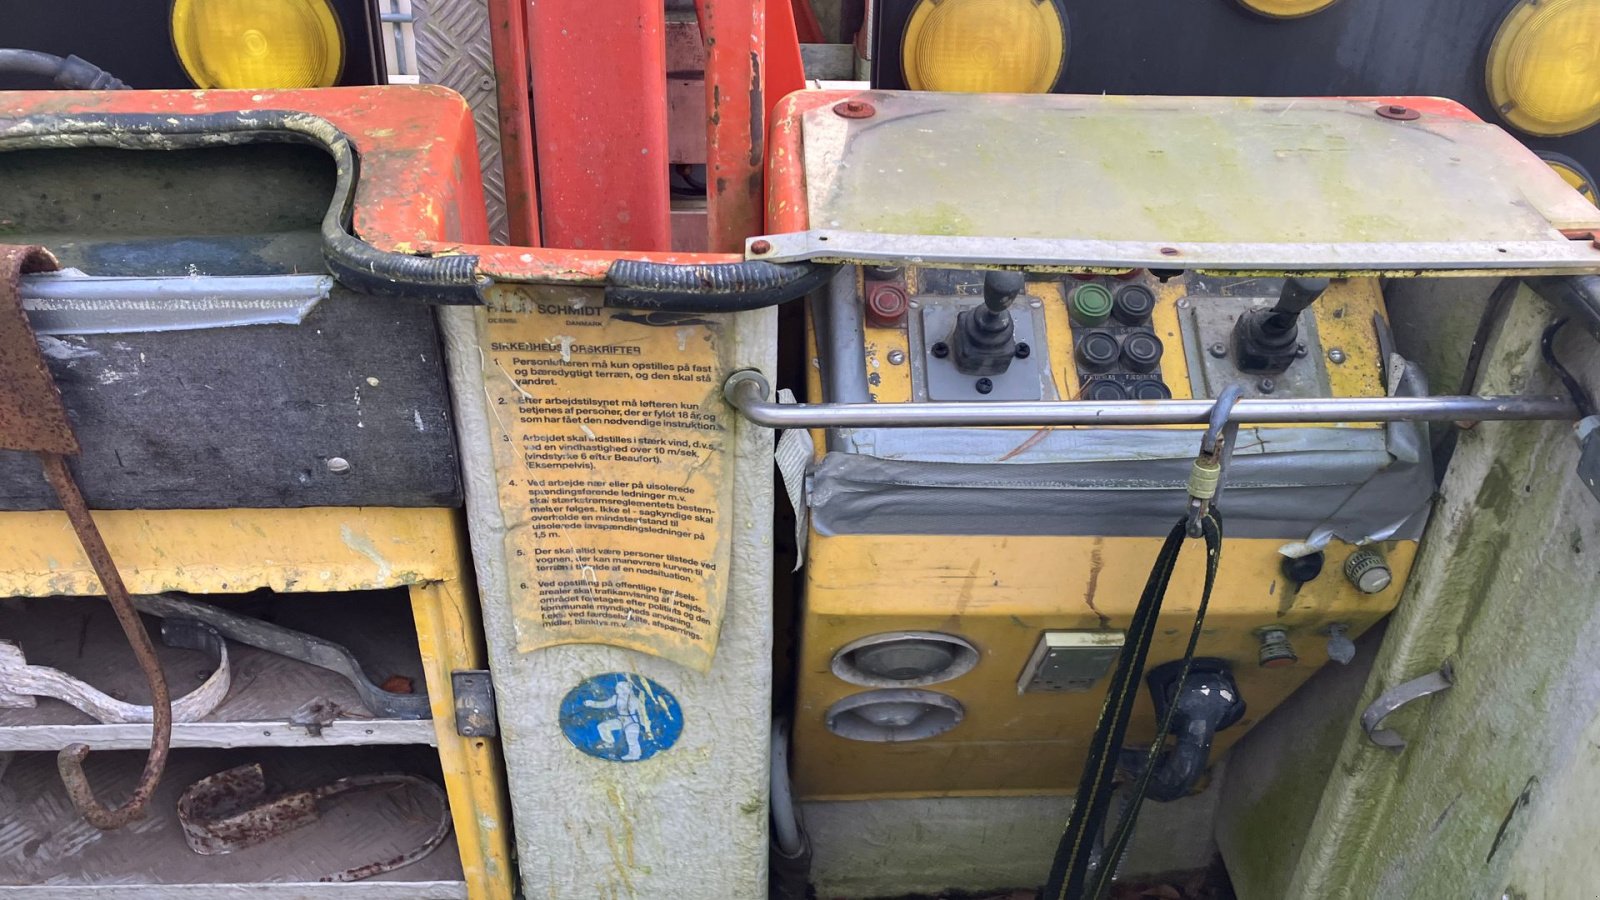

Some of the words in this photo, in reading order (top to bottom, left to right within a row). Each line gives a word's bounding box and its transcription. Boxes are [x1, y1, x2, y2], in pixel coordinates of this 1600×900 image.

[538, 304, 602, 316] SCHMIDT
[592, 360, 607, 368] må
[632, 362, 674, 371] opstilles
[678, 363, 689, 372] på
[596, 371, 633, 379] terræn,
[636, 372, 648, 380] og
[696, 374, 711, 382] stå
[681, 402, 699, 410] kun
[520, 407, 562, 415] betjenes
[576, 408, 622, 416] personer,
[703, 414, 716, 422] og
[584, 416, 601, 424] den
[668, 439, 690, 448] vind,
[622, 490, 665, 500] ledninger
[695, 515, 713, 523] skal
[694, 532, 705, 540] på
[624, 550, 664, 559] personer
[666, 554, 698, 566] tilstede
[700, 562, 716, 570] ved
[663, 562, 693, 573] kurven
[626, 599, 647, 607] efter
[684, 612, 694, 620] og
[695, 615, 711, 625] den
